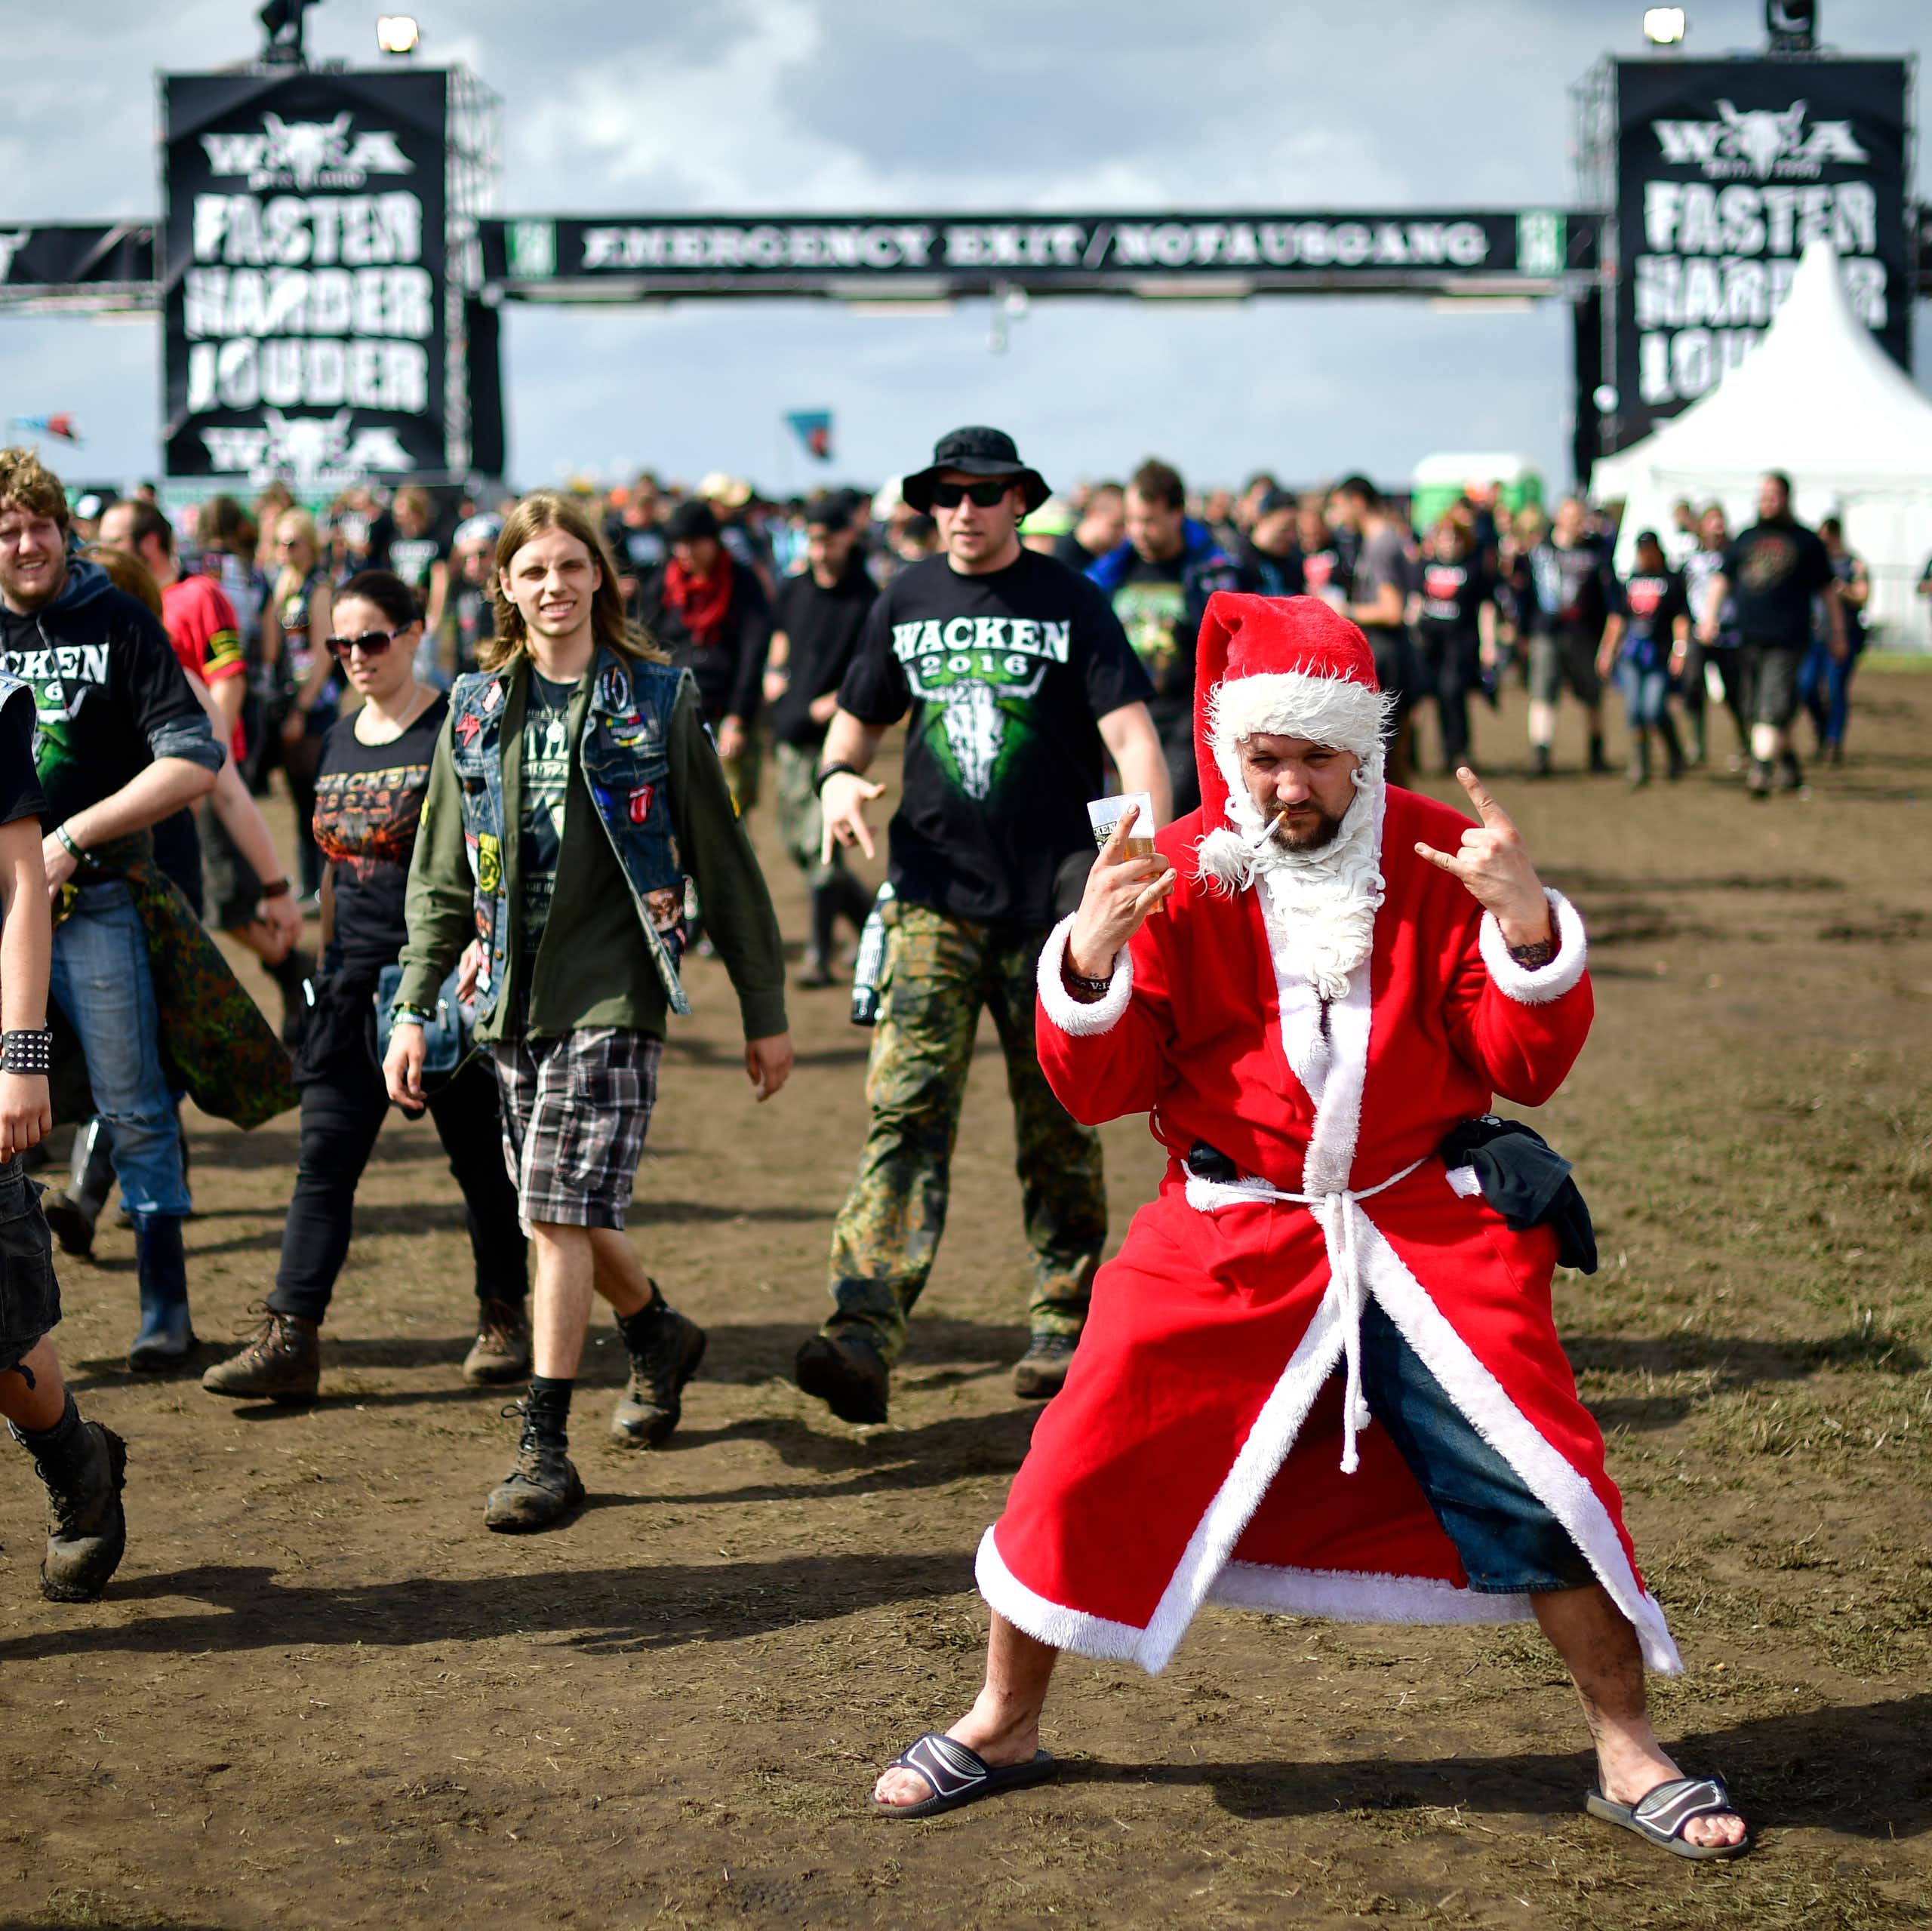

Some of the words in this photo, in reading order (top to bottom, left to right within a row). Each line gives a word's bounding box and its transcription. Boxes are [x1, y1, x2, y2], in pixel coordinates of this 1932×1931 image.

[580, 226, 936, 267] EMERGENCY
[183, 266, 434, 339] HARDER
[1633, 254, 1888, 330] HARR
[186, 338, 429, 414] LOUDER
[892, 616, 1070, 663] WACKEN
[920, 654, 1028, 677] 2016
